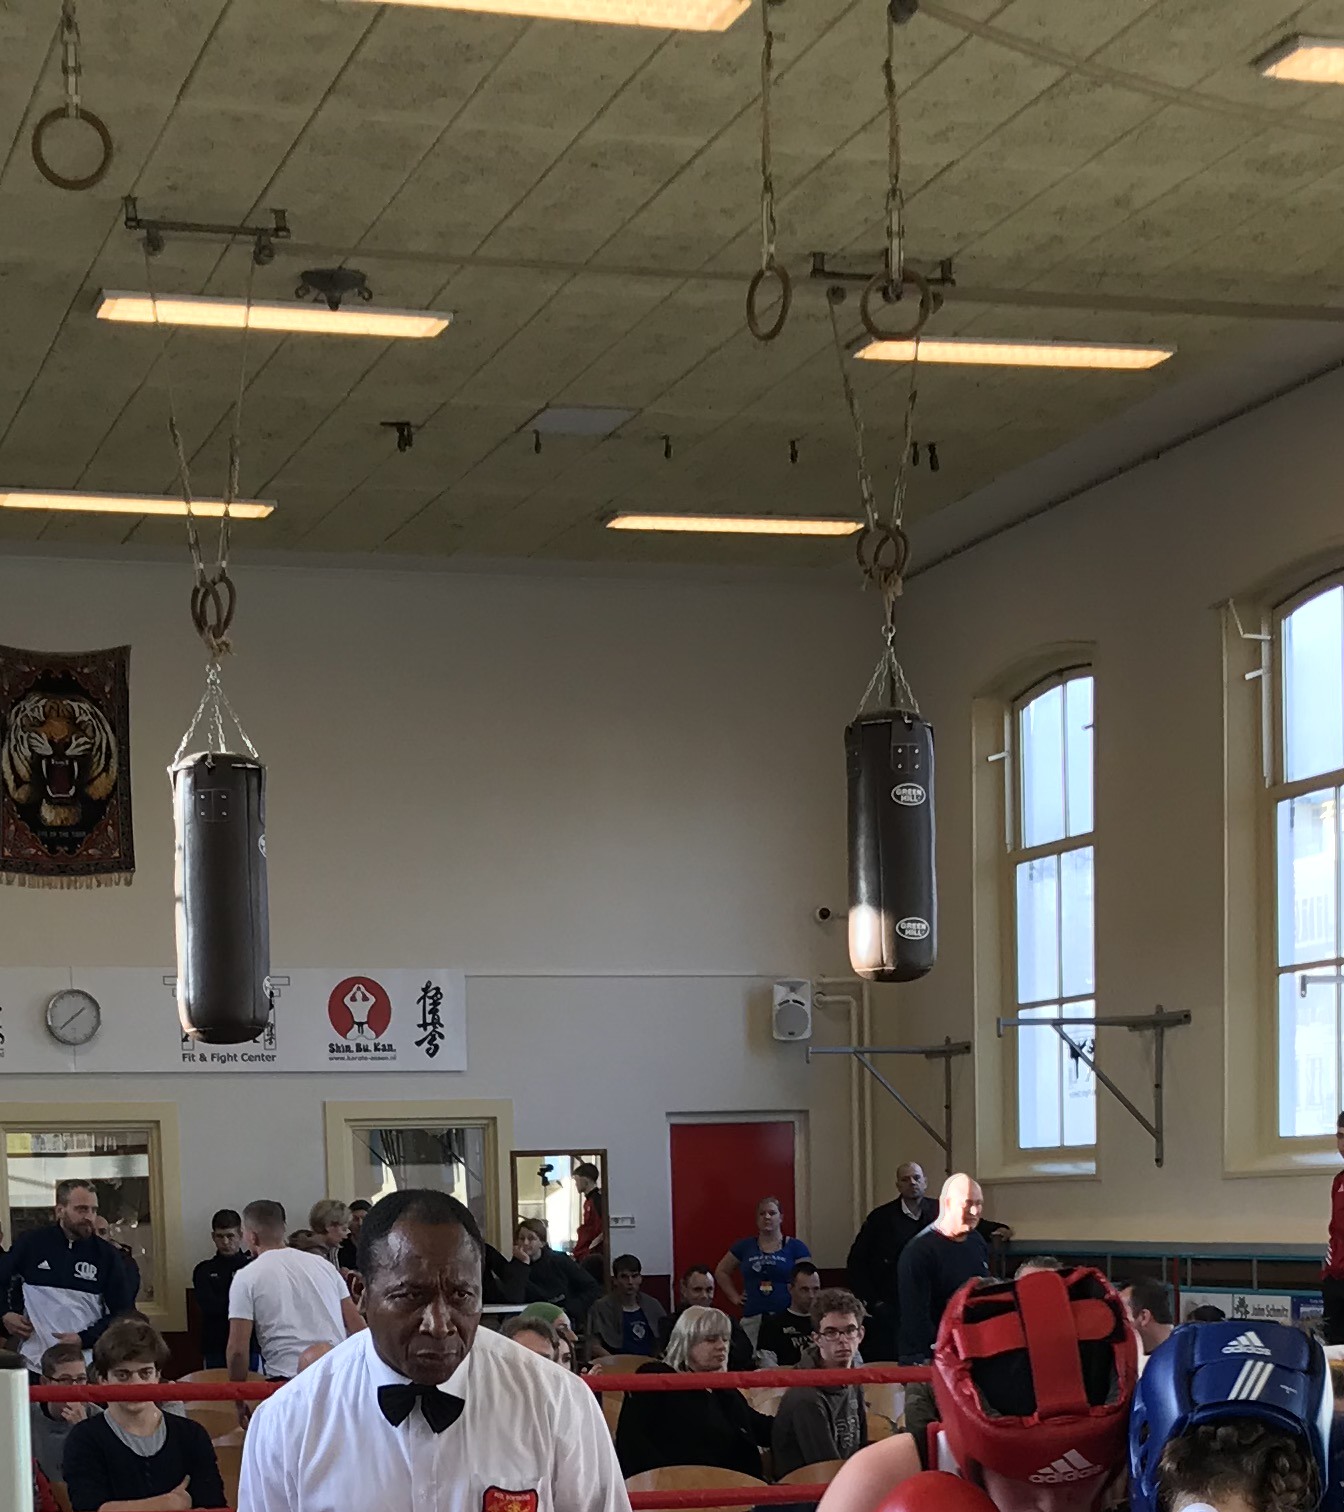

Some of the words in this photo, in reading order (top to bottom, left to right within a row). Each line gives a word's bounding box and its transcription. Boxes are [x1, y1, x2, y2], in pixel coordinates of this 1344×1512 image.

[895, 788, 922, 796] GREEN
[900, 922, 927, 930] GREEN
[182, 1053, 195, 1062] Fit
[198, 1053, 208, 1062] &
[210, 1053, 238, 1064] Fight
[241, 1053, 277, 1062] Center
[1029, 1463, 1105, 1484] adidas
